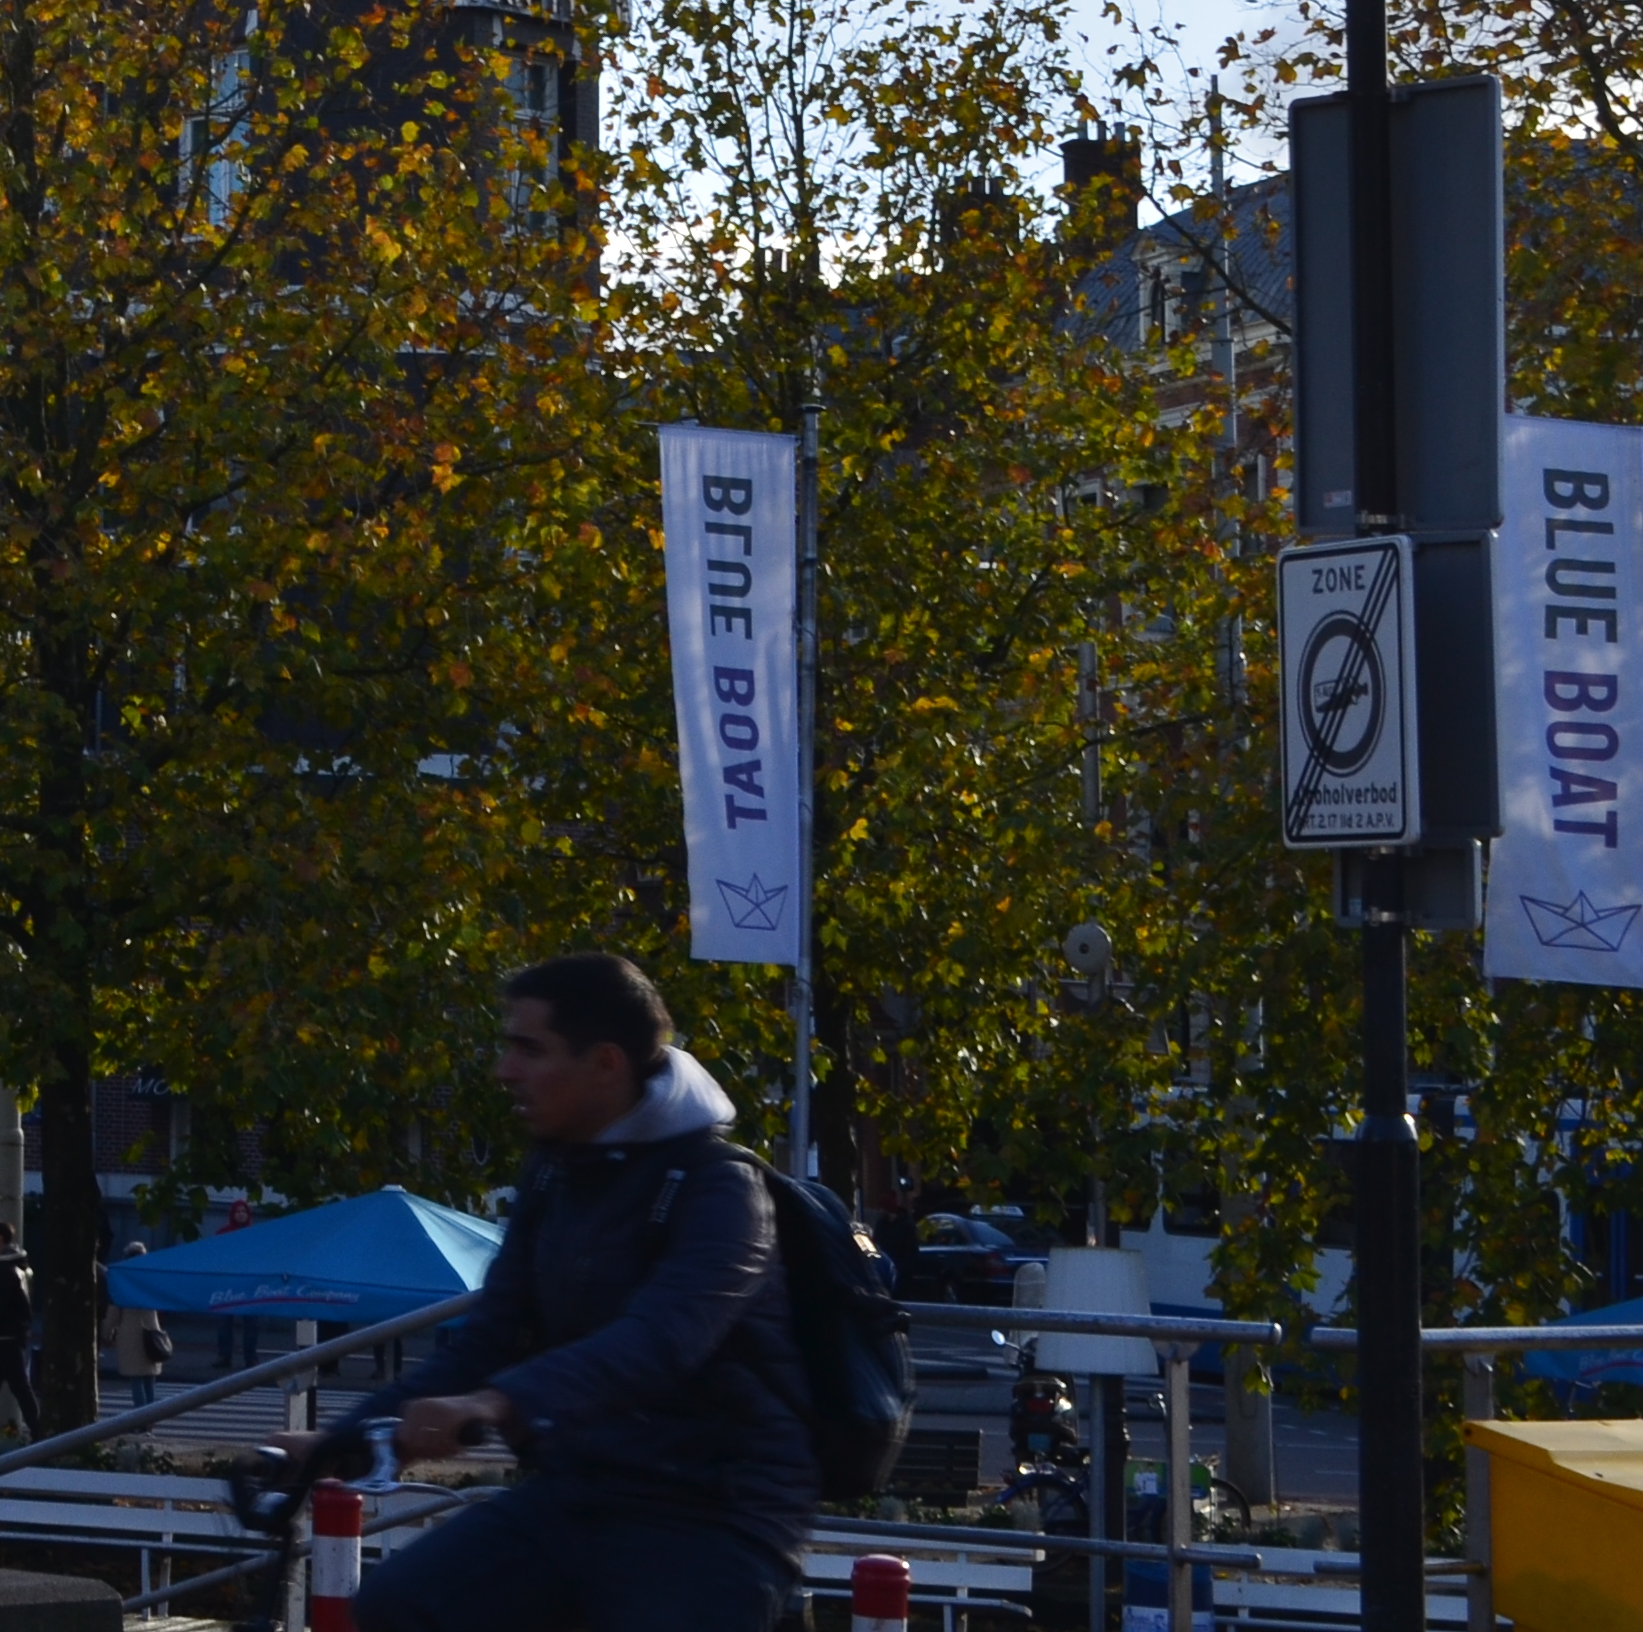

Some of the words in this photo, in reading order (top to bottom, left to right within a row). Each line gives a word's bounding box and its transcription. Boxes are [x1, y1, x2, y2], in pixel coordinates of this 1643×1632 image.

[1542, 467, 1618, 643] BLUE
[1312, 564, 1366, 594] ZONE
[1543, 670, 1619, 849] BOAT
[1295, 782, 1397, 806] oholverbod
[1356, 812, 1364, 828] 2
